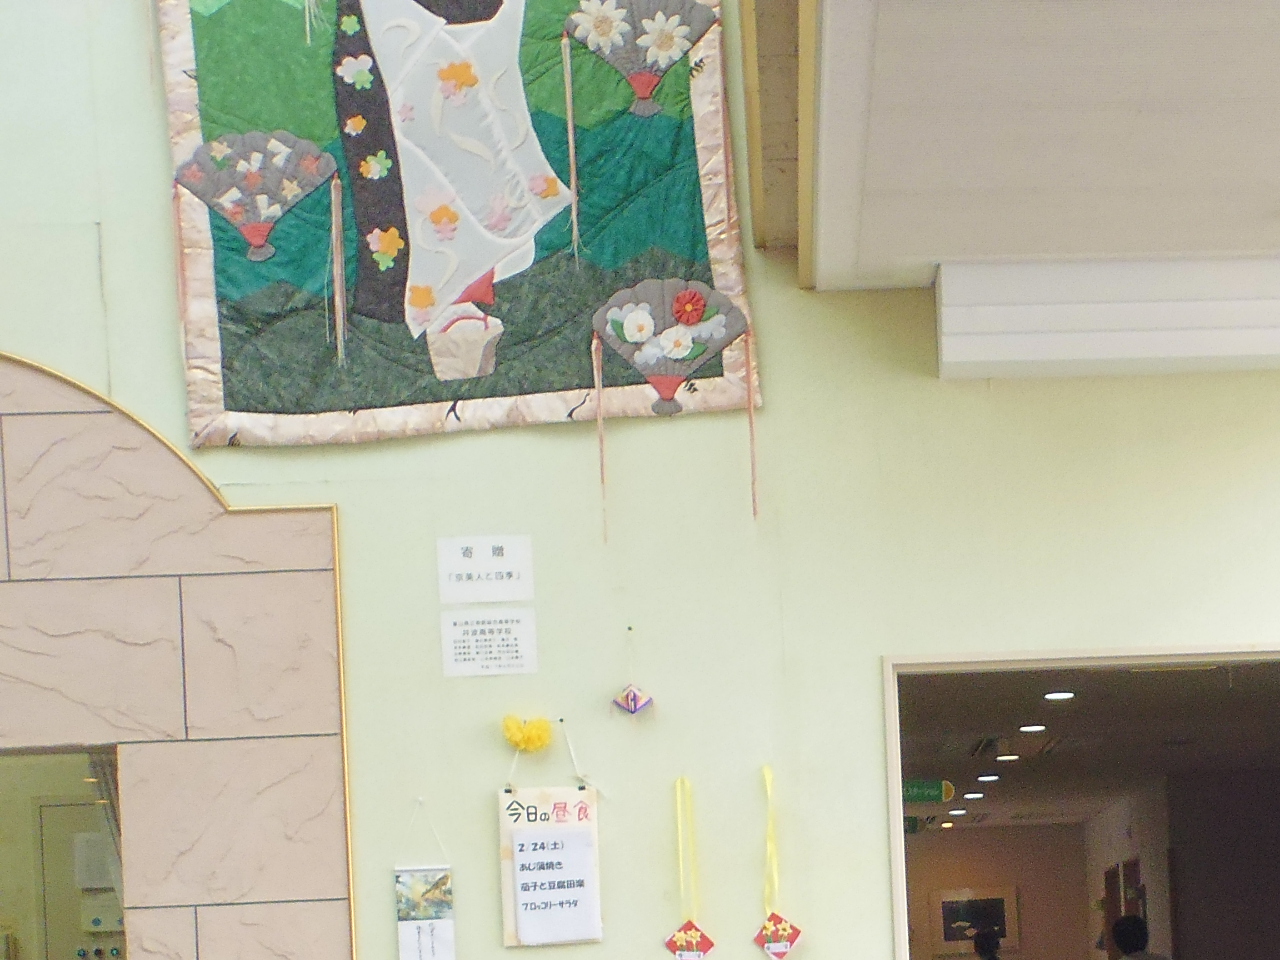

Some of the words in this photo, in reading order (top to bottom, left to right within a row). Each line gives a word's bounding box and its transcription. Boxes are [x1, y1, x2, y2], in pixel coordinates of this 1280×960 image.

[505, 800, 592, 823] 今日の昼食
